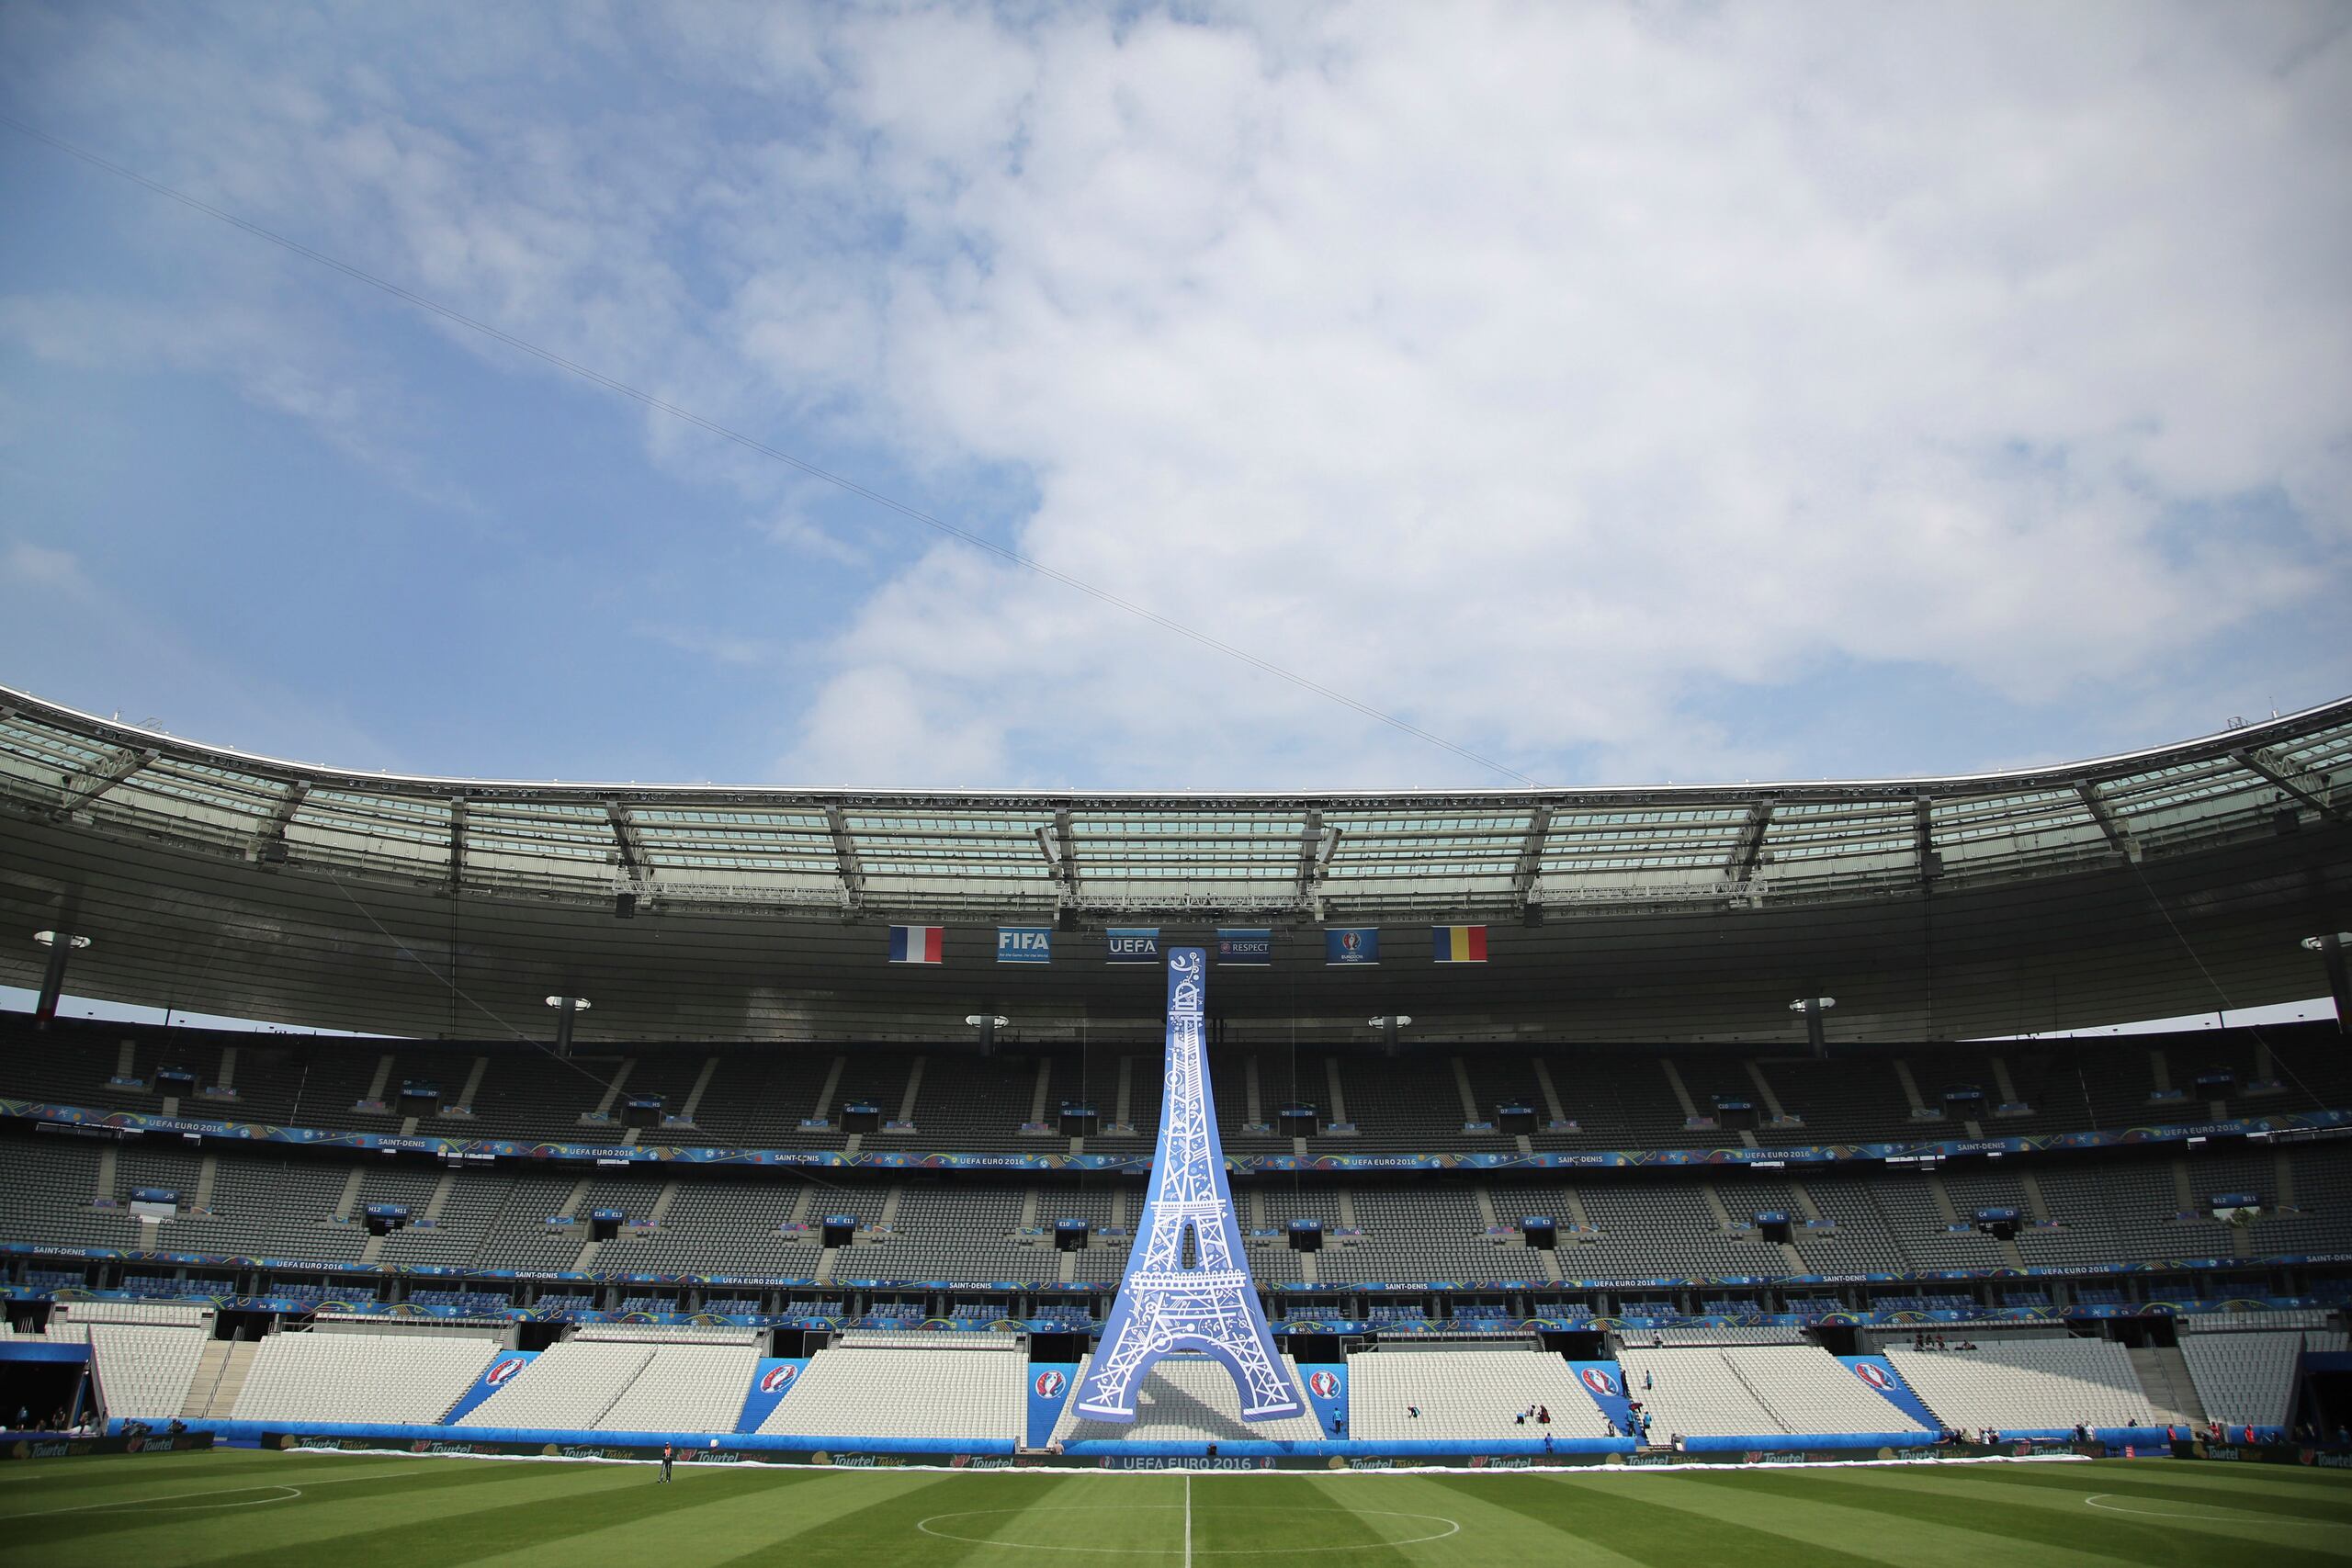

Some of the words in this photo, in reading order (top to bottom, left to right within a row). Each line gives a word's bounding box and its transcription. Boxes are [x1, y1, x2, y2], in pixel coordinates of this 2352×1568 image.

[1000, 933, 1049, 949] FIFA
[1110, 941, 1156, 953] UEFA
[149, 1120, 173, 1129] UEFA
[175, 1122, 199, 1131] EURO
[201, 1124, 223, 1133] 2016
[2164, 1129, 2188, 1137] UEFA
[2190, 1126, 2215, 1134] EURO
[2217, 1124, 2241, 1133] 2016
[378, 1138, 425, 1147] SAINT-DENIS
[1957, 1143, 2006, 1151] SAINT-DENIS
[33, 1247, 86, 1256] SAINT-DENIS
[515, 1271, 559, 1280] SAINT-DENIS
[2064, 1267, 2087, 1275] EURO
[2088, 1266, 2109, 1274] 2016
[143, 1438, 175, 1452] Tourtel
[301, 1438, 341, 1450] Tourtel
[431, 1442, 471, 1454] Tourtel
[32, 1442, 69, 1459] Tourtel
[563, 1447, 604, 1458] Tourtel
[1898, 1450, 1939, 1460] Tourtel
[2031, 1446, 2073, 1456] Tourtel
[2207, 1446, 2239, 1460] Tourtel
[697, 1451, 739, 1462] Tourtel
[833, 1455, 876, 1466] Tourtel
[1626, 1455, 1669, 1465] Tourtel
[1764, 1452, 1804, 1463] Tourtel
[971, 1457, 1013, 1468] Tourtel
[1124, 1459, 1164, 1470] UEFA
[1170, 1458, 1210, 1469] EURO
[1214, 1458, 1251, 1470] 2016
[1351, 1459, 1393, 1470] Tourtel
[1489, 1457, 1531, 1468] Tourtel
